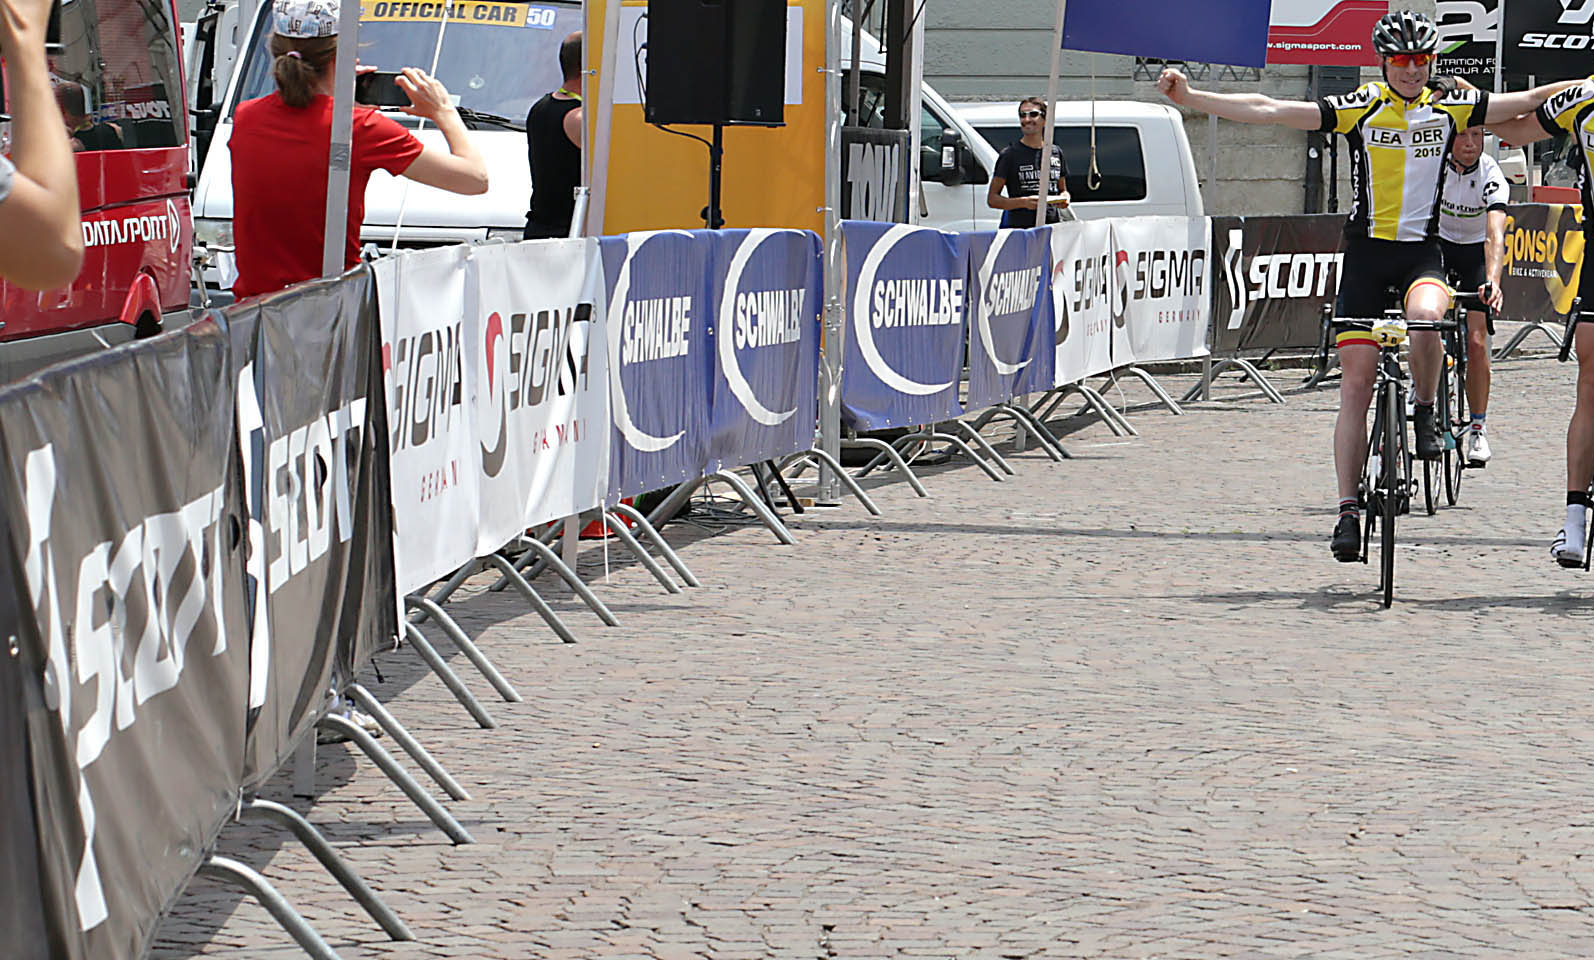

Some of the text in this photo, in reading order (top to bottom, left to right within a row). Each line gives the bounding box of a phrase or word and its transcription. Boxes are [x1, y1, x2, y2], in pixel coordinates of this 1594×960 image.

[374, 2, 556, 26] OFFICIAL CAR 50
[1414, 146, 1442, 158] 2015
[82, 215, 169, 247] DATASPORT
[1133, 249, 1205, 301] SIGMA
[872, 279, 962, 329] SCHWALBE
